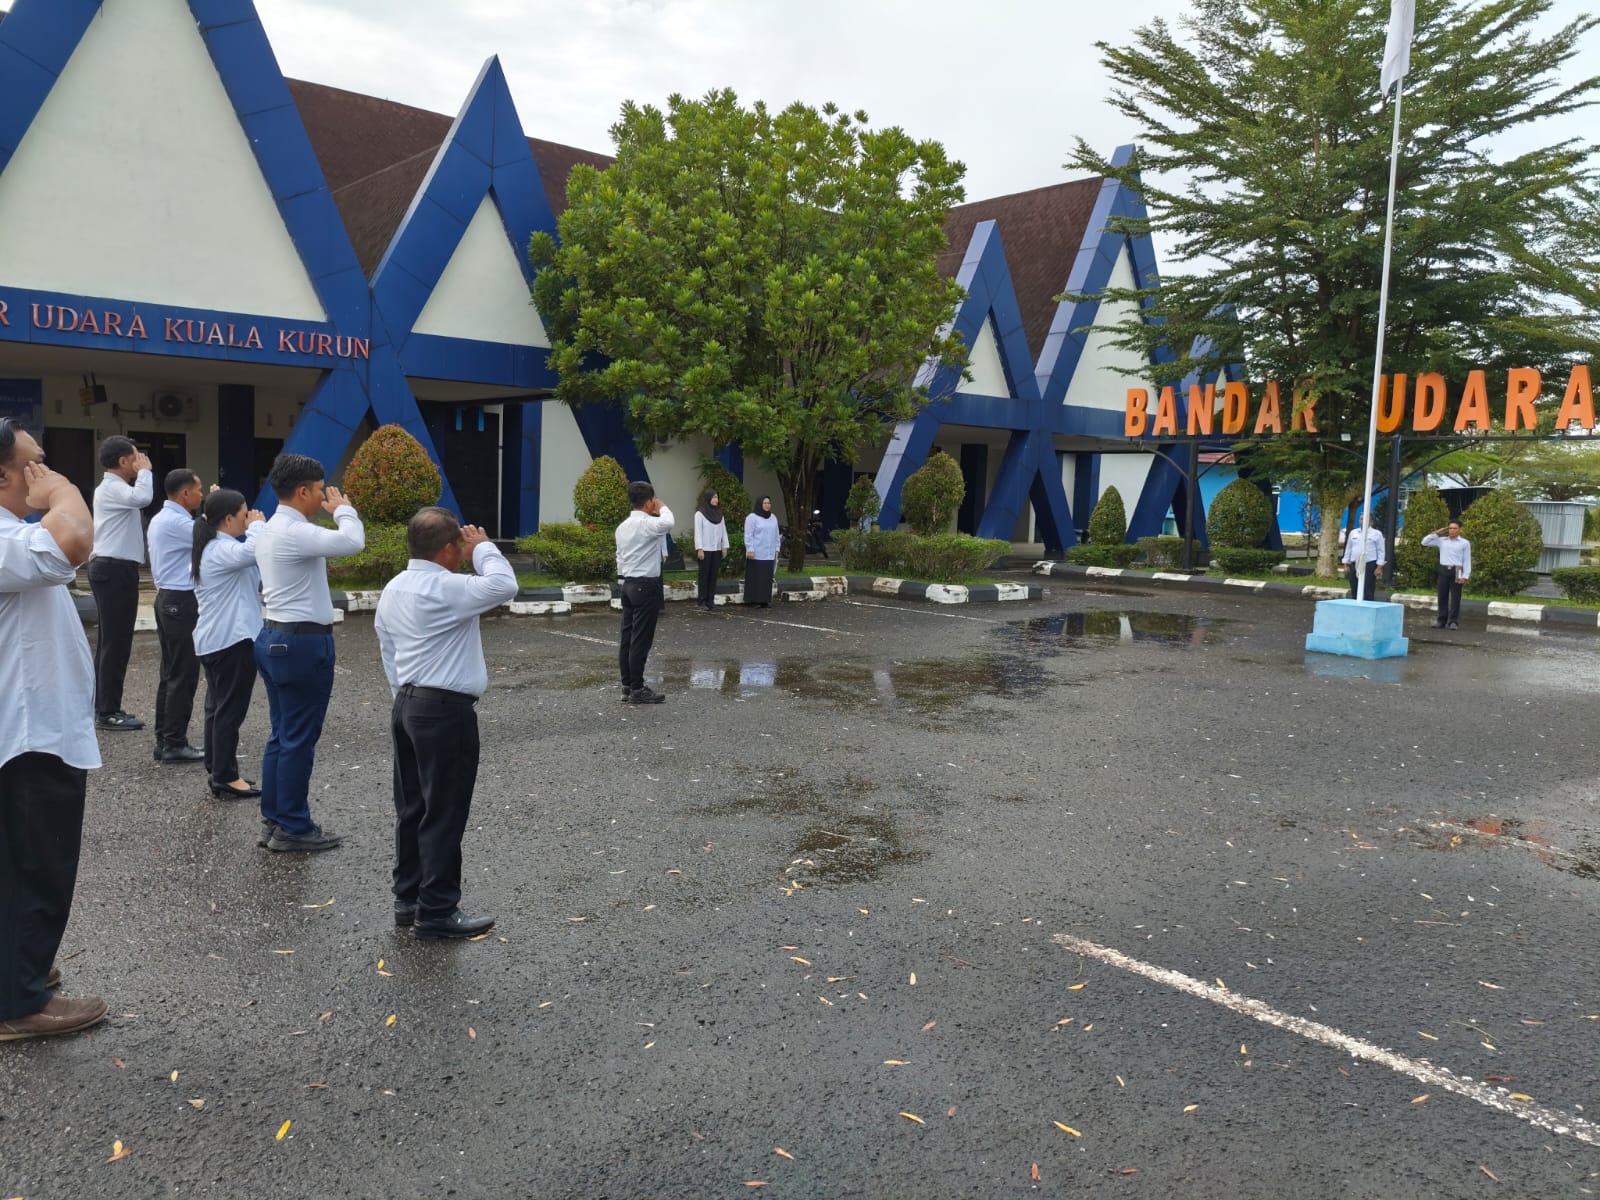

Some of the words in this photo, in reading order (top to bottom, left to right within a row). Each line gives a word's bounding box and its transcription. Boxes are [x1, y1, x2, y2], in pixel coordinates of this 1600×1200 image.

[32, 303, 148, 339] UDARA
[164, 317, 263, 350] KUALA
[278, 329, 370, 360] KURUN
[1124, 379, 1319, 437] BANDAR
[1376, 365, 1595, 432] UDARA
